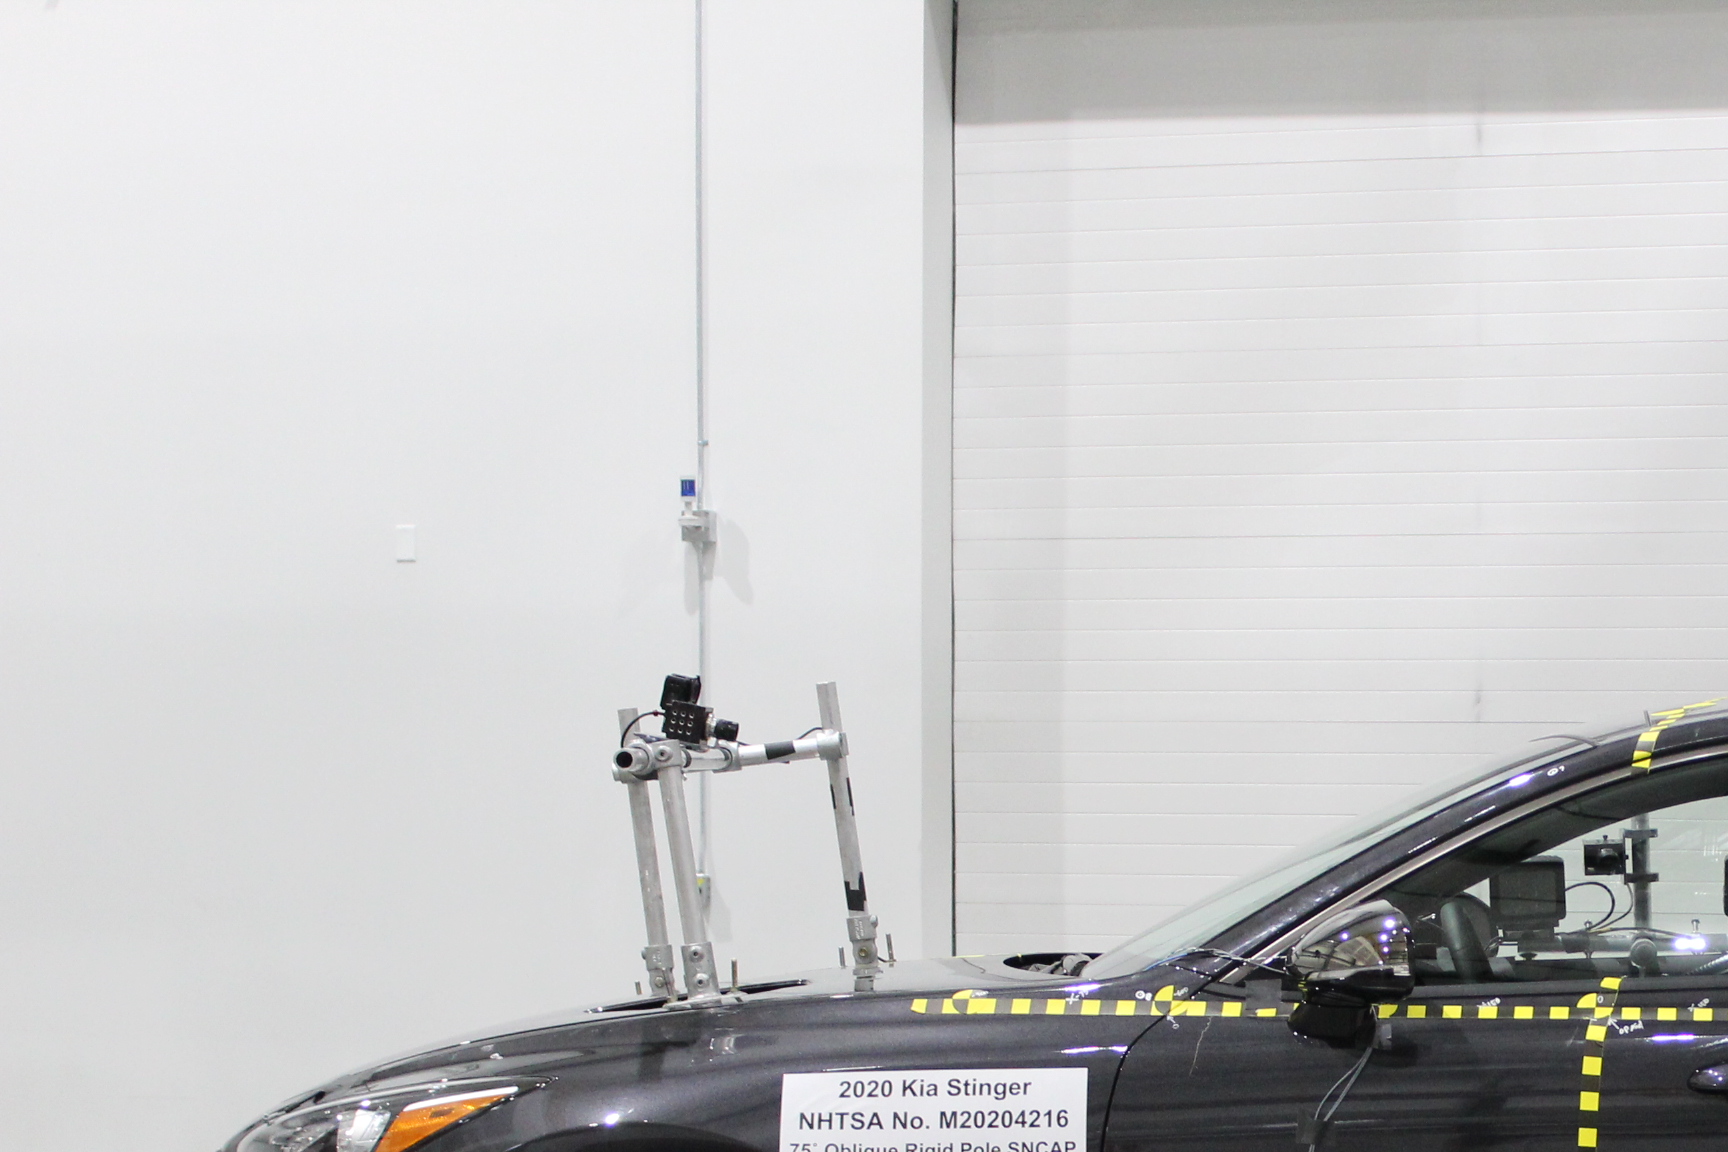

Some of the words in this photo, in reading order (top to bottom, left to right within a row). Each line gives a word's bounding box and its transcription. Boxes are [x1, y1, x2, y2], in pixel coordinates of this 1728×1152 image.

[838, 1080, 893, 1098] 2020
[902, 1079, 938, 1097] Kia
[946, 1078, 1032, 1100] Stinger
[799, 1112, 883, 1130] NHTSA
[892, 1112, 931, 1130] No.
[939, 1109, 1069, 1129] M20204216
